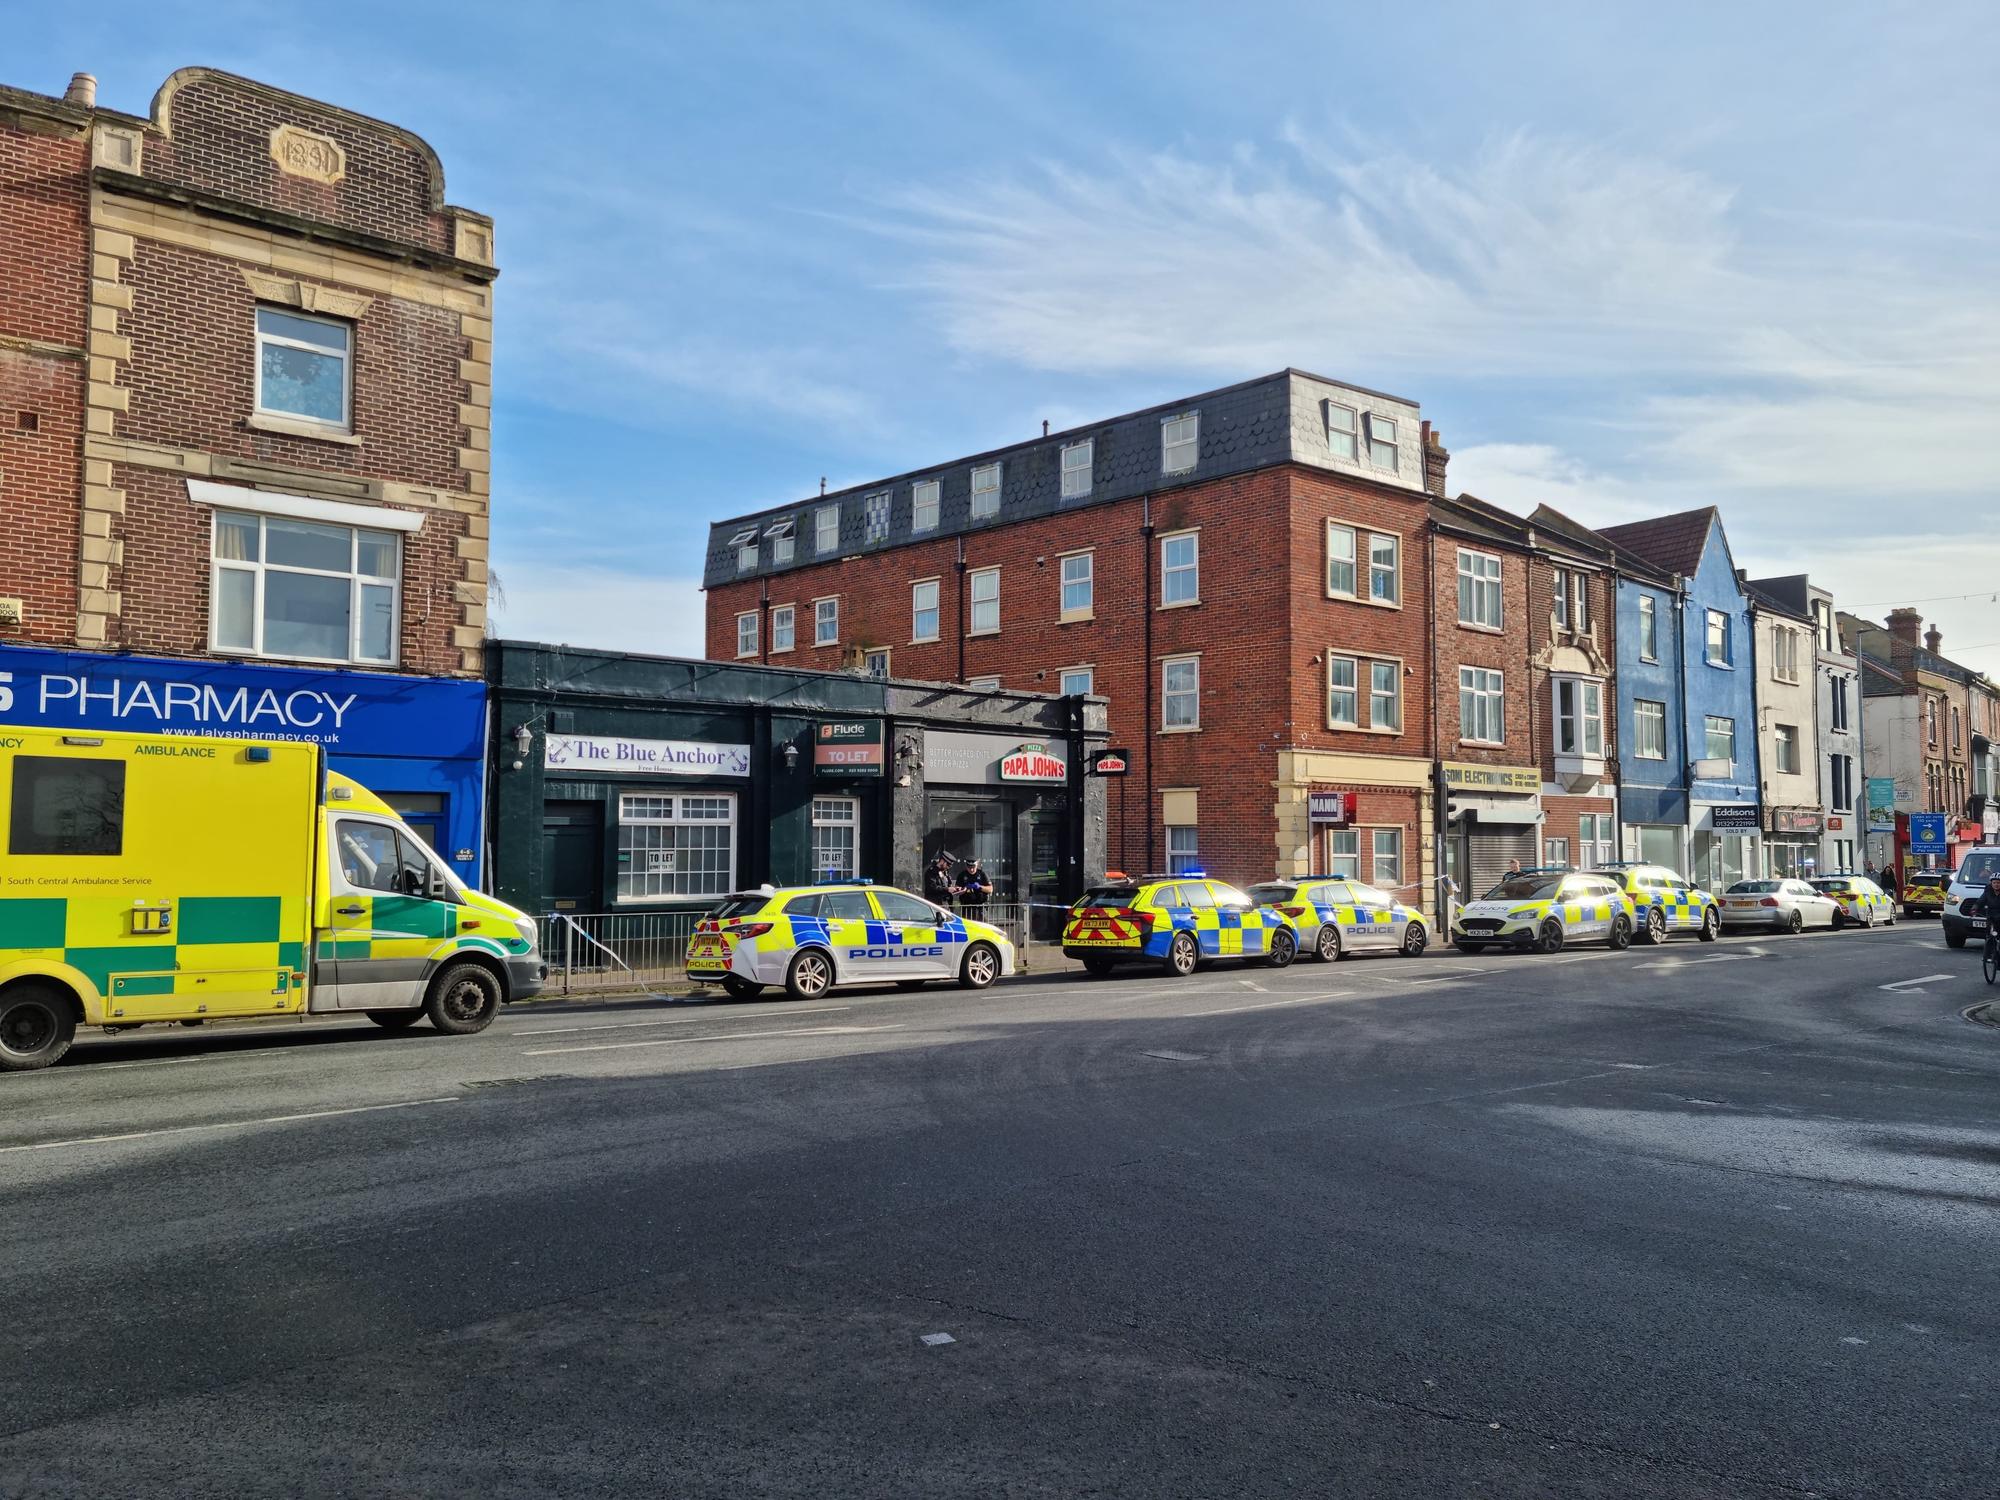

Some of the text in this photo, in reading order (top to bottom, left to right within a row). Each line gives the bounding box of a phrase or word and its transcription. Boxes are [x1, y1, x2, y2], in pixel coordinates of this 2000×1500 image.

[40, 674, 357, 728] PHARMACY
[833, 724, 865, 734] Flude
[134, 745, 216, 758] AMBULANCE
[573, 740, 725, 765] The Blue Anchor
[828, 751, 868, 762] TO LET
[1003, 757, 1065, 778] PAPA JOHN'S
[1311, 798, 1337, 813] MANN
[1715, 807, 1756, 817] Eddisons
[650, 854, 673, 862] TO LET
[821, 853, 841, 861] TO LET
[8, 877, 152, 885] South Central Ambulance Service
[1347, 926, 1396, 935] POLICE
[848, 946, 943, 959] POLICE
